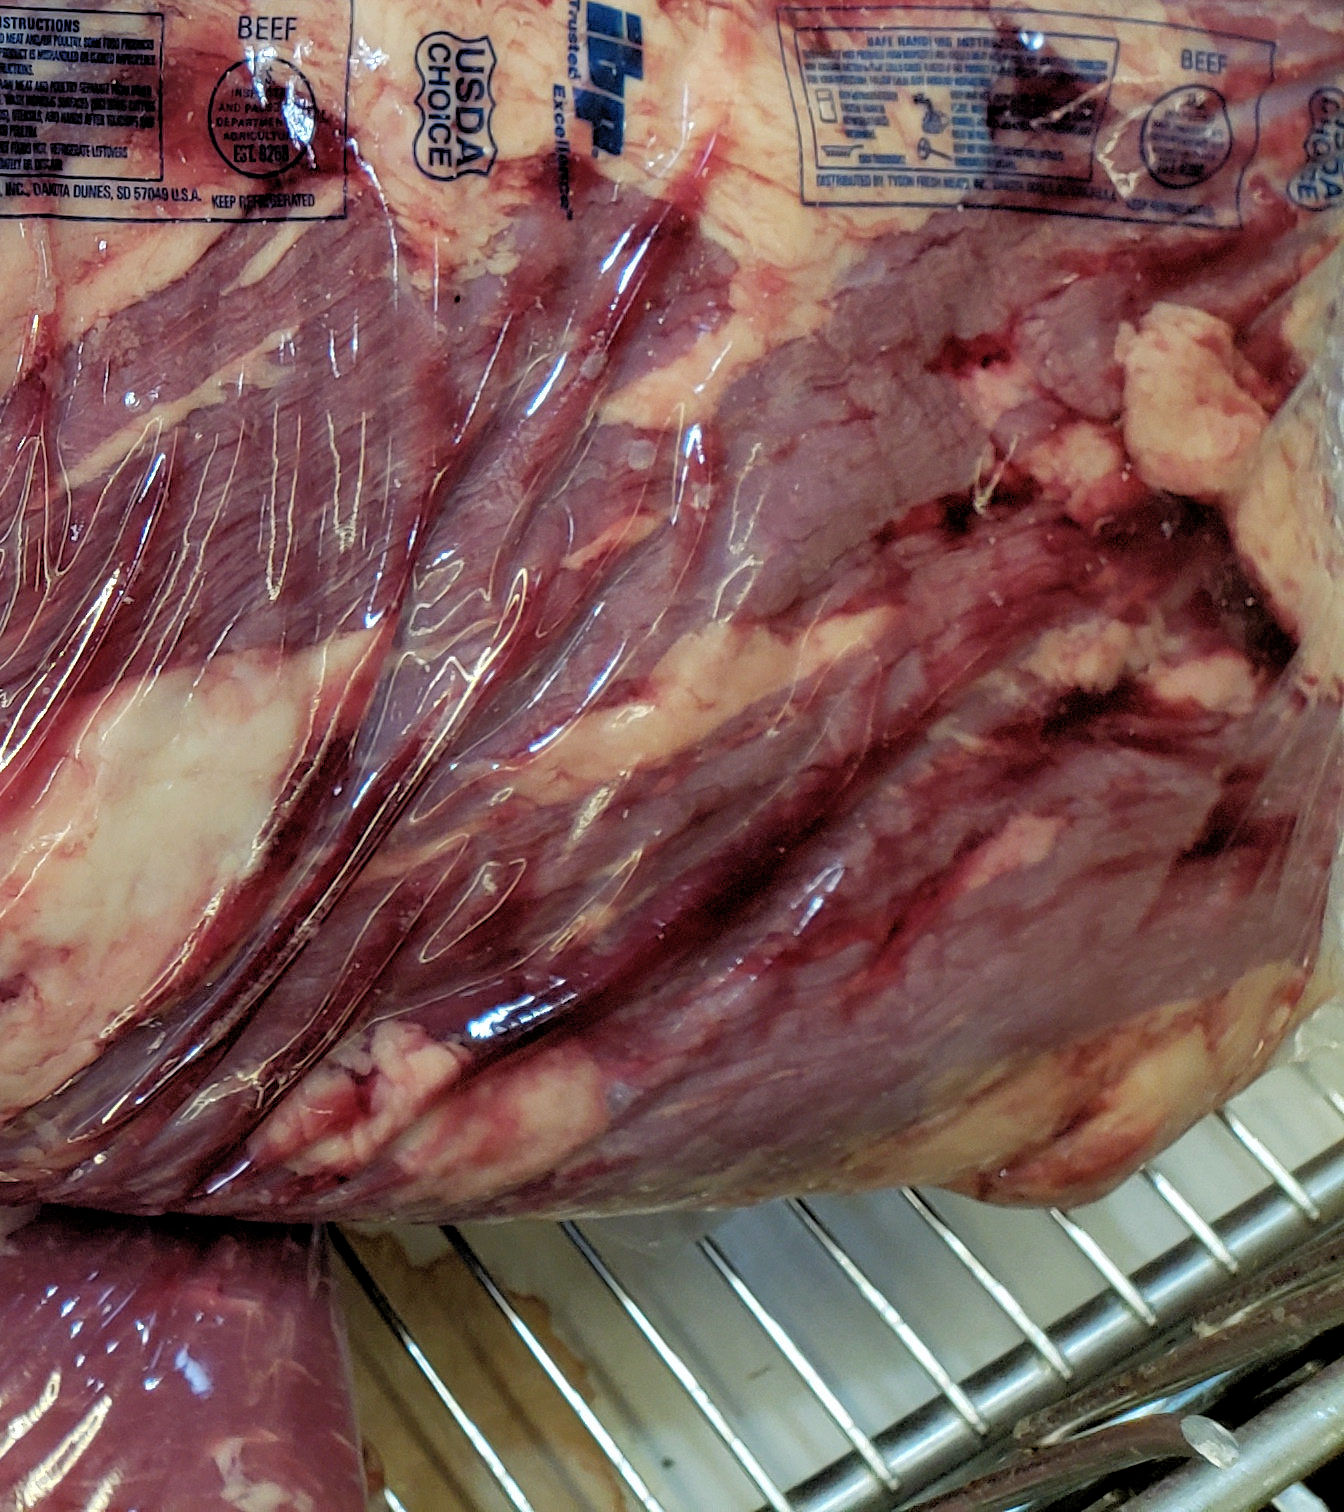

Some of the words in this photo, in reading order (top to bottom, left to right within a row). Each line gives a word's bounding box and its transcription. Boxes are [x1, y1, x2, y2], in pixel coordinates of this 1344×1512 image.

[238, 16, 298, 41] BEEF
[1181, 48, 1228, 74] BEEF
[427, 42, 452, 168] CHOICE
[455, 47, 486, 167] USDA
[73, 184, 114, 200] DUNES,
[116, 186, 131, 200] SD
[134, 186, 169, 202] 57049
[171, 187, 201, 202] U.S.A.
[212, 195, 236, 209] KEEP
